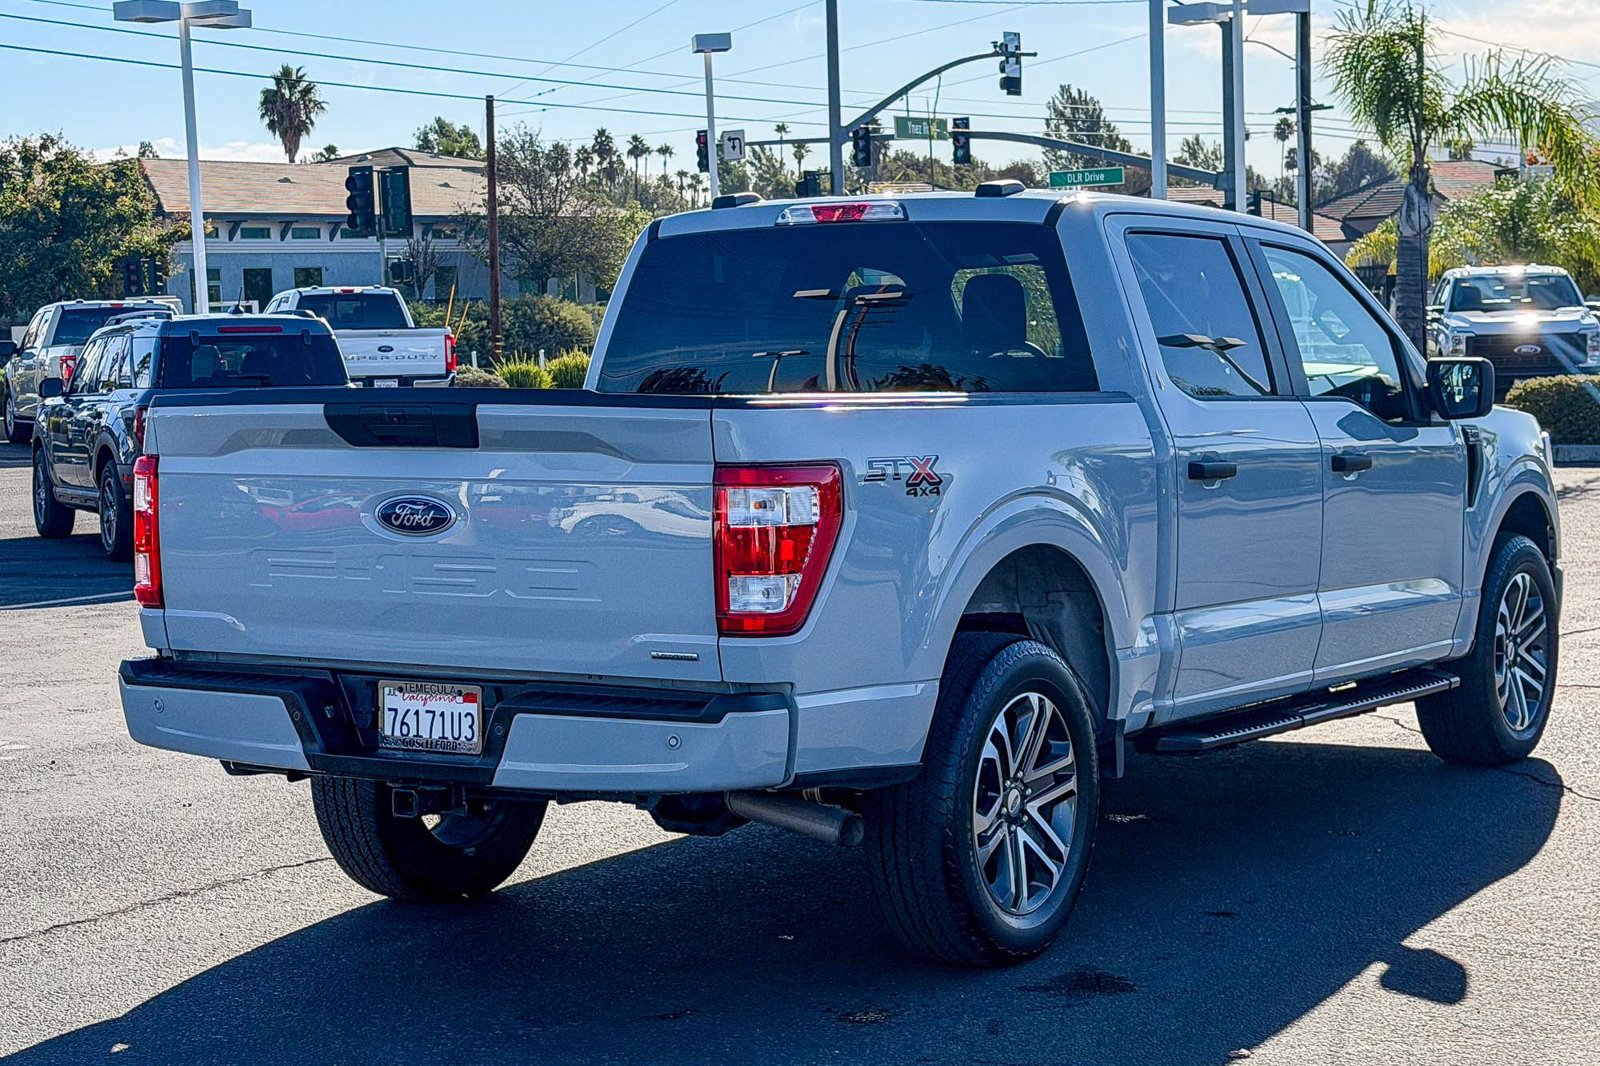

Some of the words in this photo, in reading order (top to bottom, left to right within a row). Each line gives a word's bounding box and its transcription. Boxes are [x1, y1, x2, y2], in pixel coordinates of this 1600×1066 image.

[907, 121, 922, 135] Ynez
[1067, 173, 1083, 183] DLR
[1085, 171, 1105, 182] Drive
[864, 455, 943, 487] STX
[391, 503, 435, 526] Ford
[248, 548, 603, 602] F-150
[403, 682, 457, 695] TEMECULA
[402, 692, 457, 707] California
[387, 707, 475, 742] 76171U3
[436, 740, 458, 751] FORD
